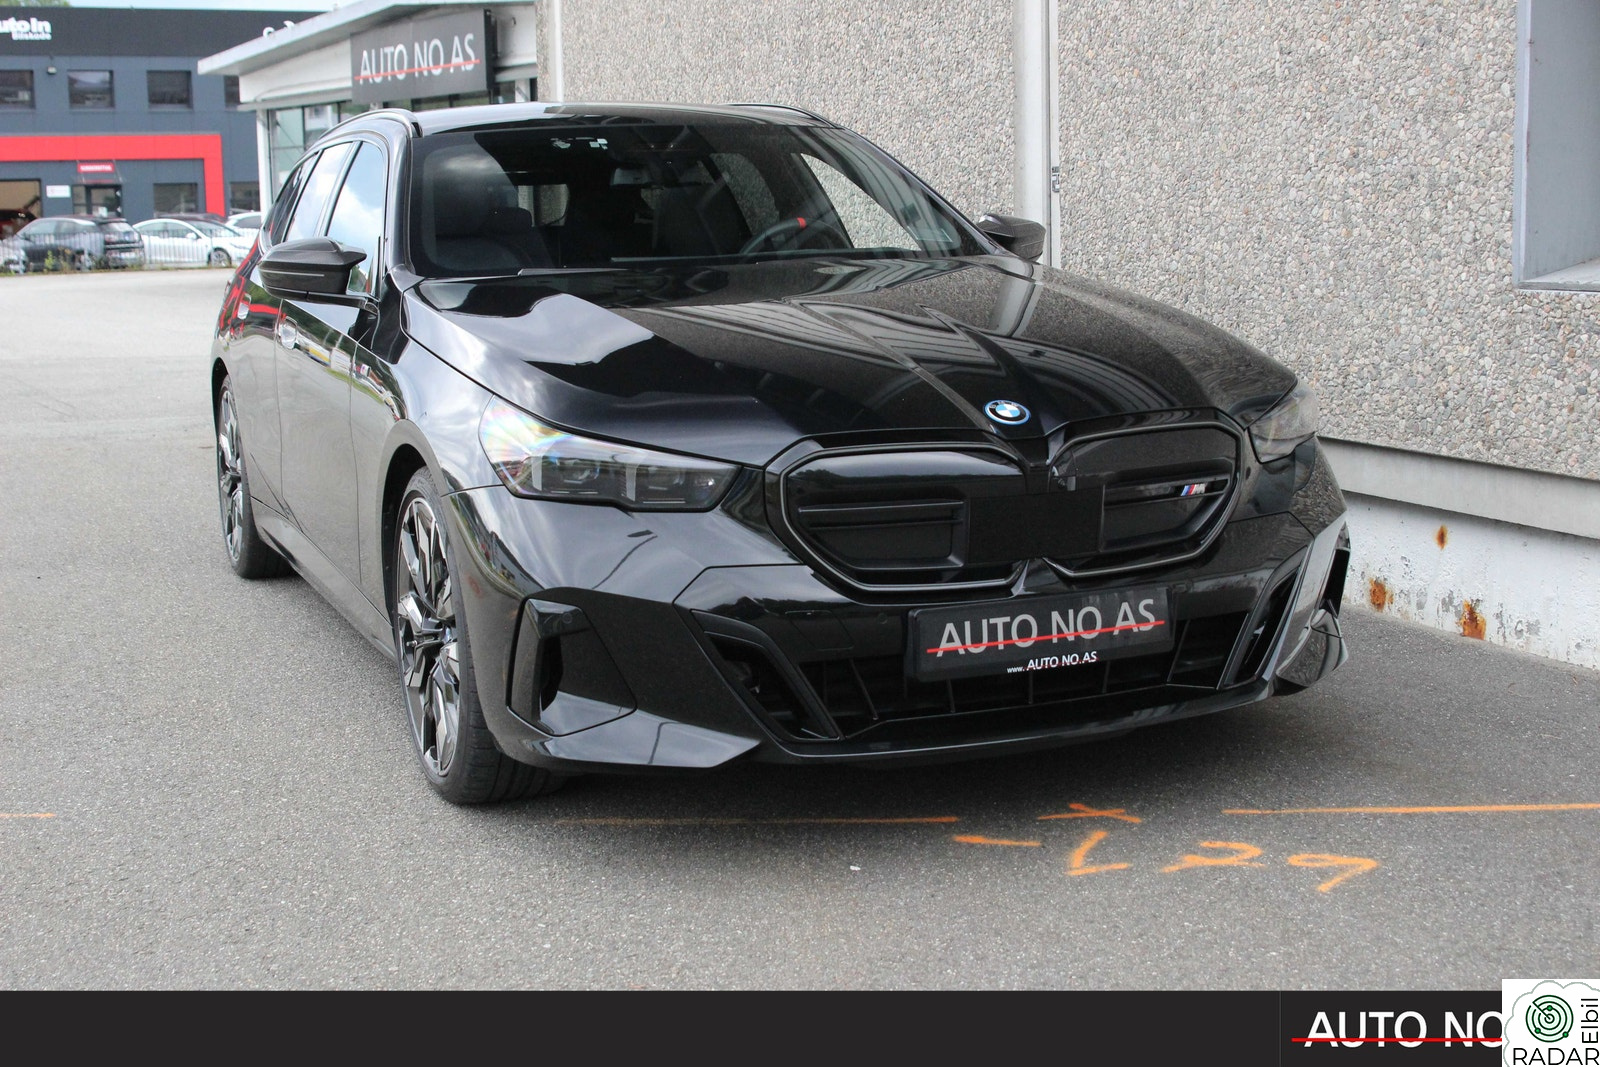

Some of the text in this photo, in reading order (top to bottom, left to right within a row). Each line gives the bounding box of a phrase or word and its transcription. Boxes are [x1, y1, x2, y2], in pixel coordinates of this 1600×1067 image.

[359, 33, 476, 85] AUTO NO AS
[936, 598, 1156, 657] AUTO NO AS
[1026, 656, 1059, 671] AUTO
